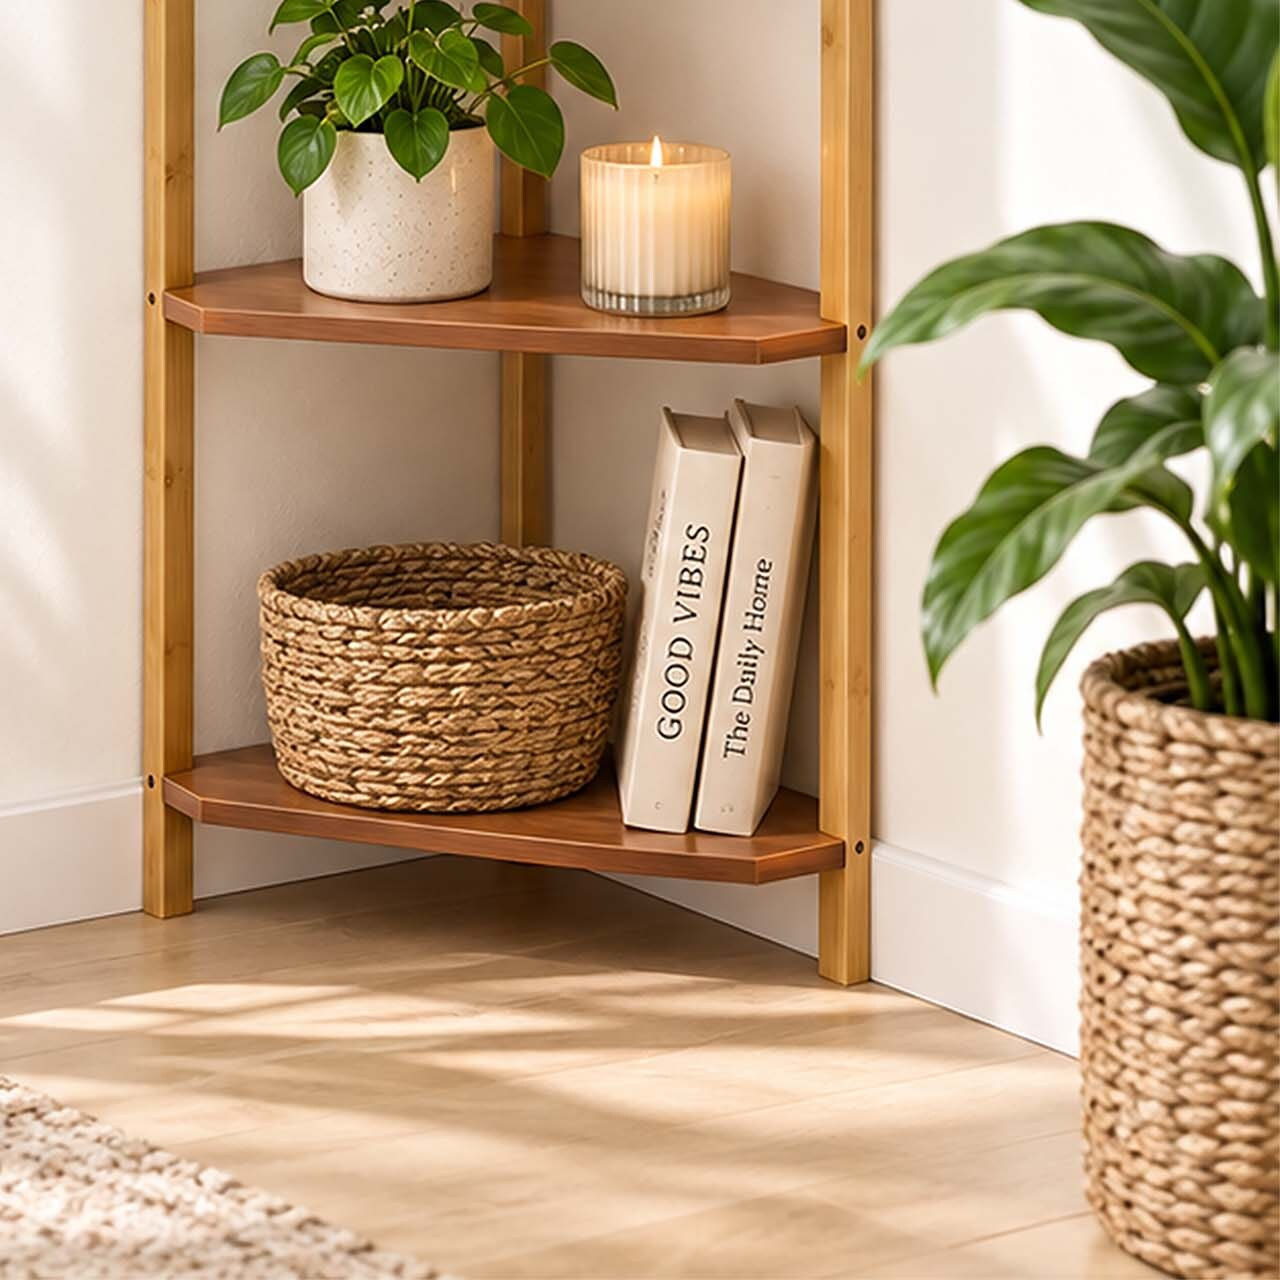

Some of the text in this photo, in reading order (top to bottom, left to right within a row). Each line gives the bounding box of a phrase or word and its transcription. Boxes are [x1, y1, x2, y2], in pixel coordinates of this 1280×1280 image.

[657, 523, 711, 740] GOOD VIBES
[723, 558, 773, 759] The Daily Home
